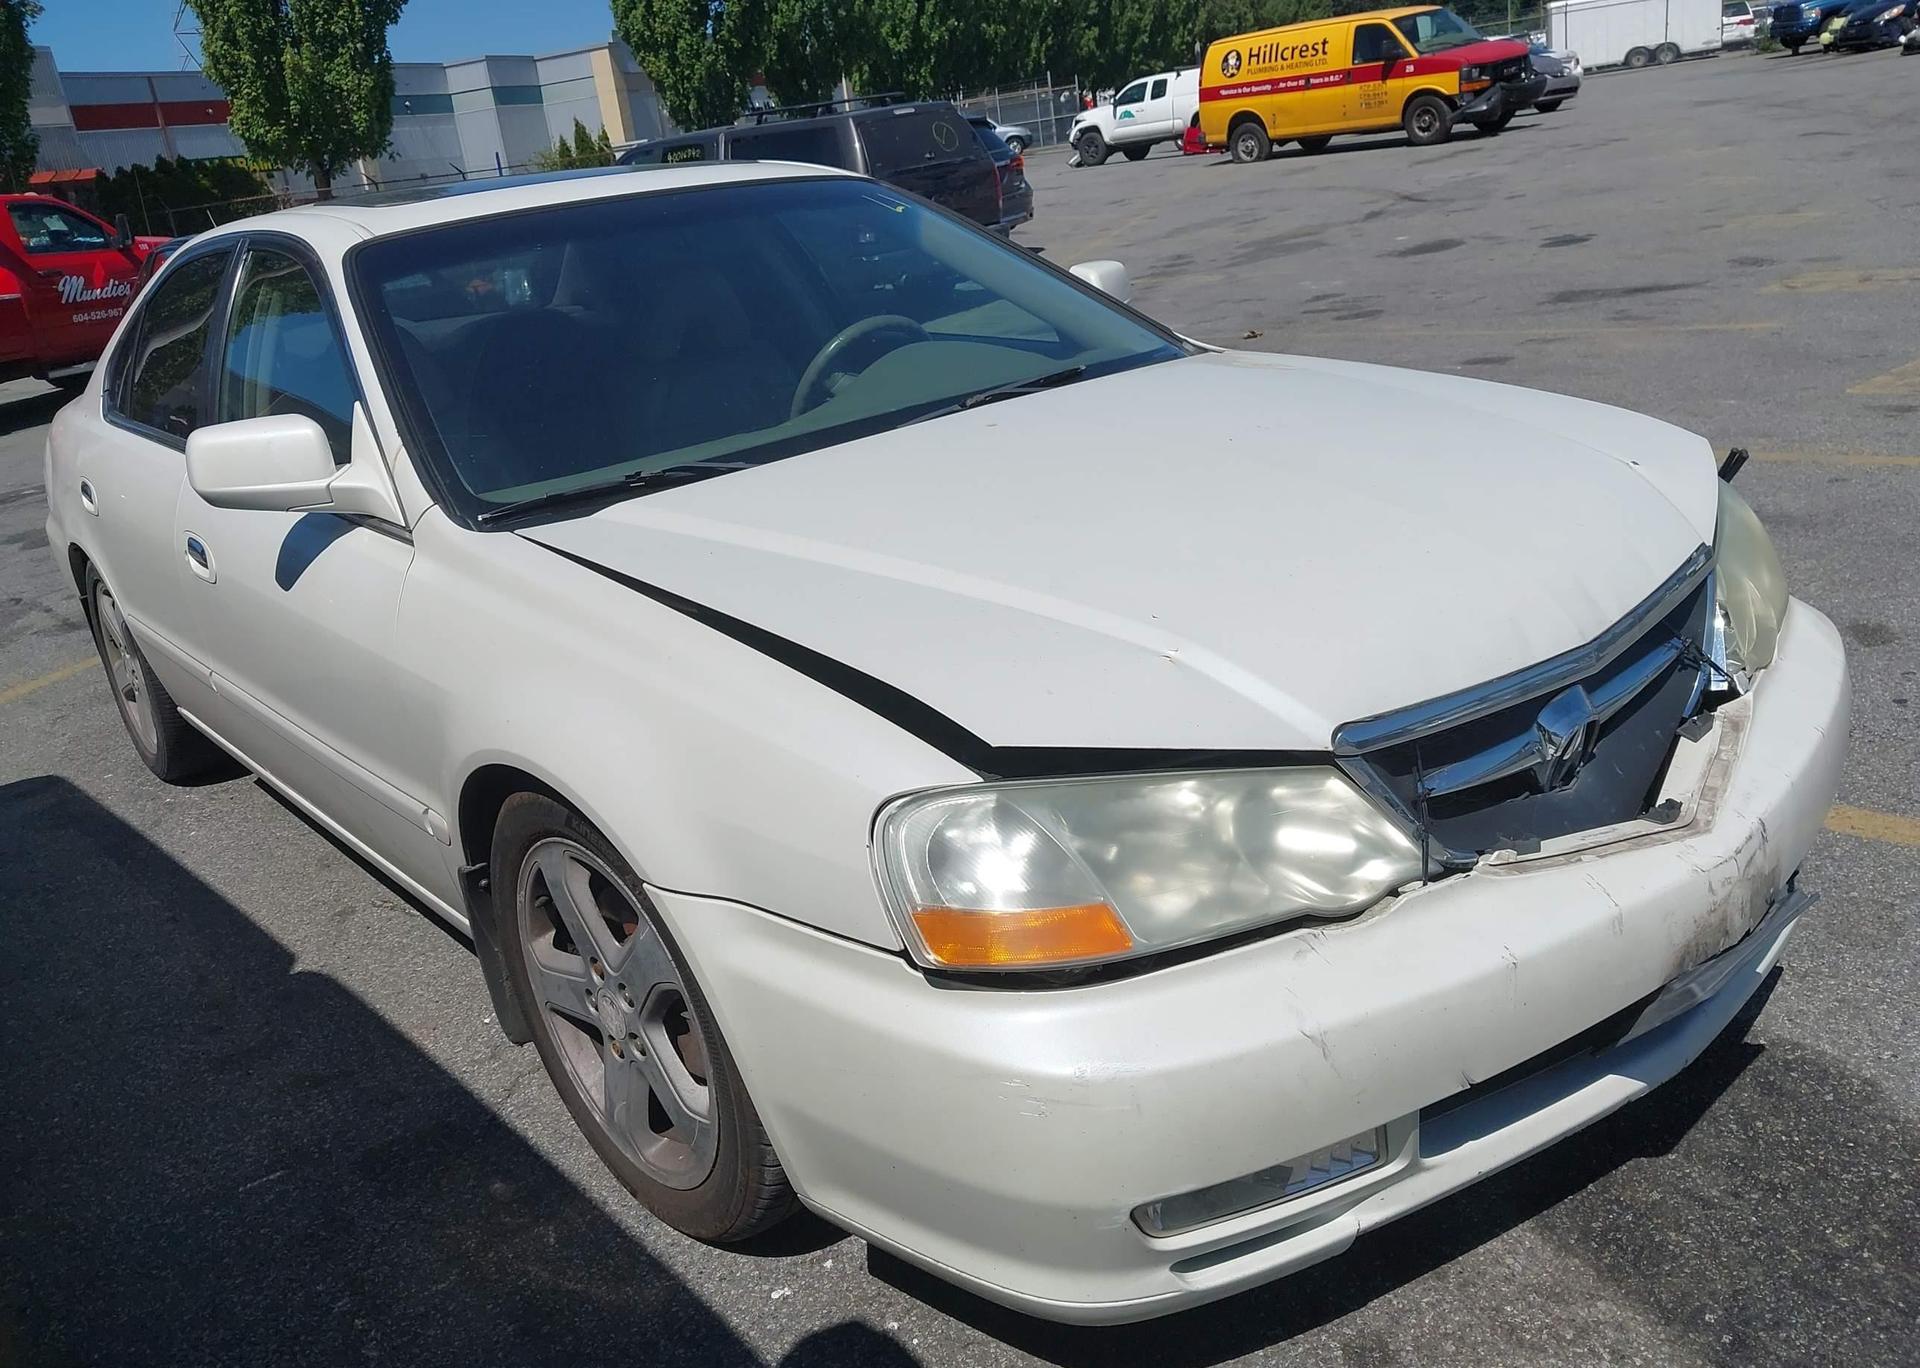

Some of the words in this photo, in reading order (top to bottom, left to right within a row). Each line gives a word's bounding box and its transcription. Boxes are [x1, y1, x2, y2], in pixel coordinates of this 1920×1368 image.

[1248, 37, 1329, 66] Hillcrest
[1247, 64, 1279, 76] PLUMBING
[1285, 60, 1314, 70] HEATING
[58, 275, 131, 304] Mundie's
